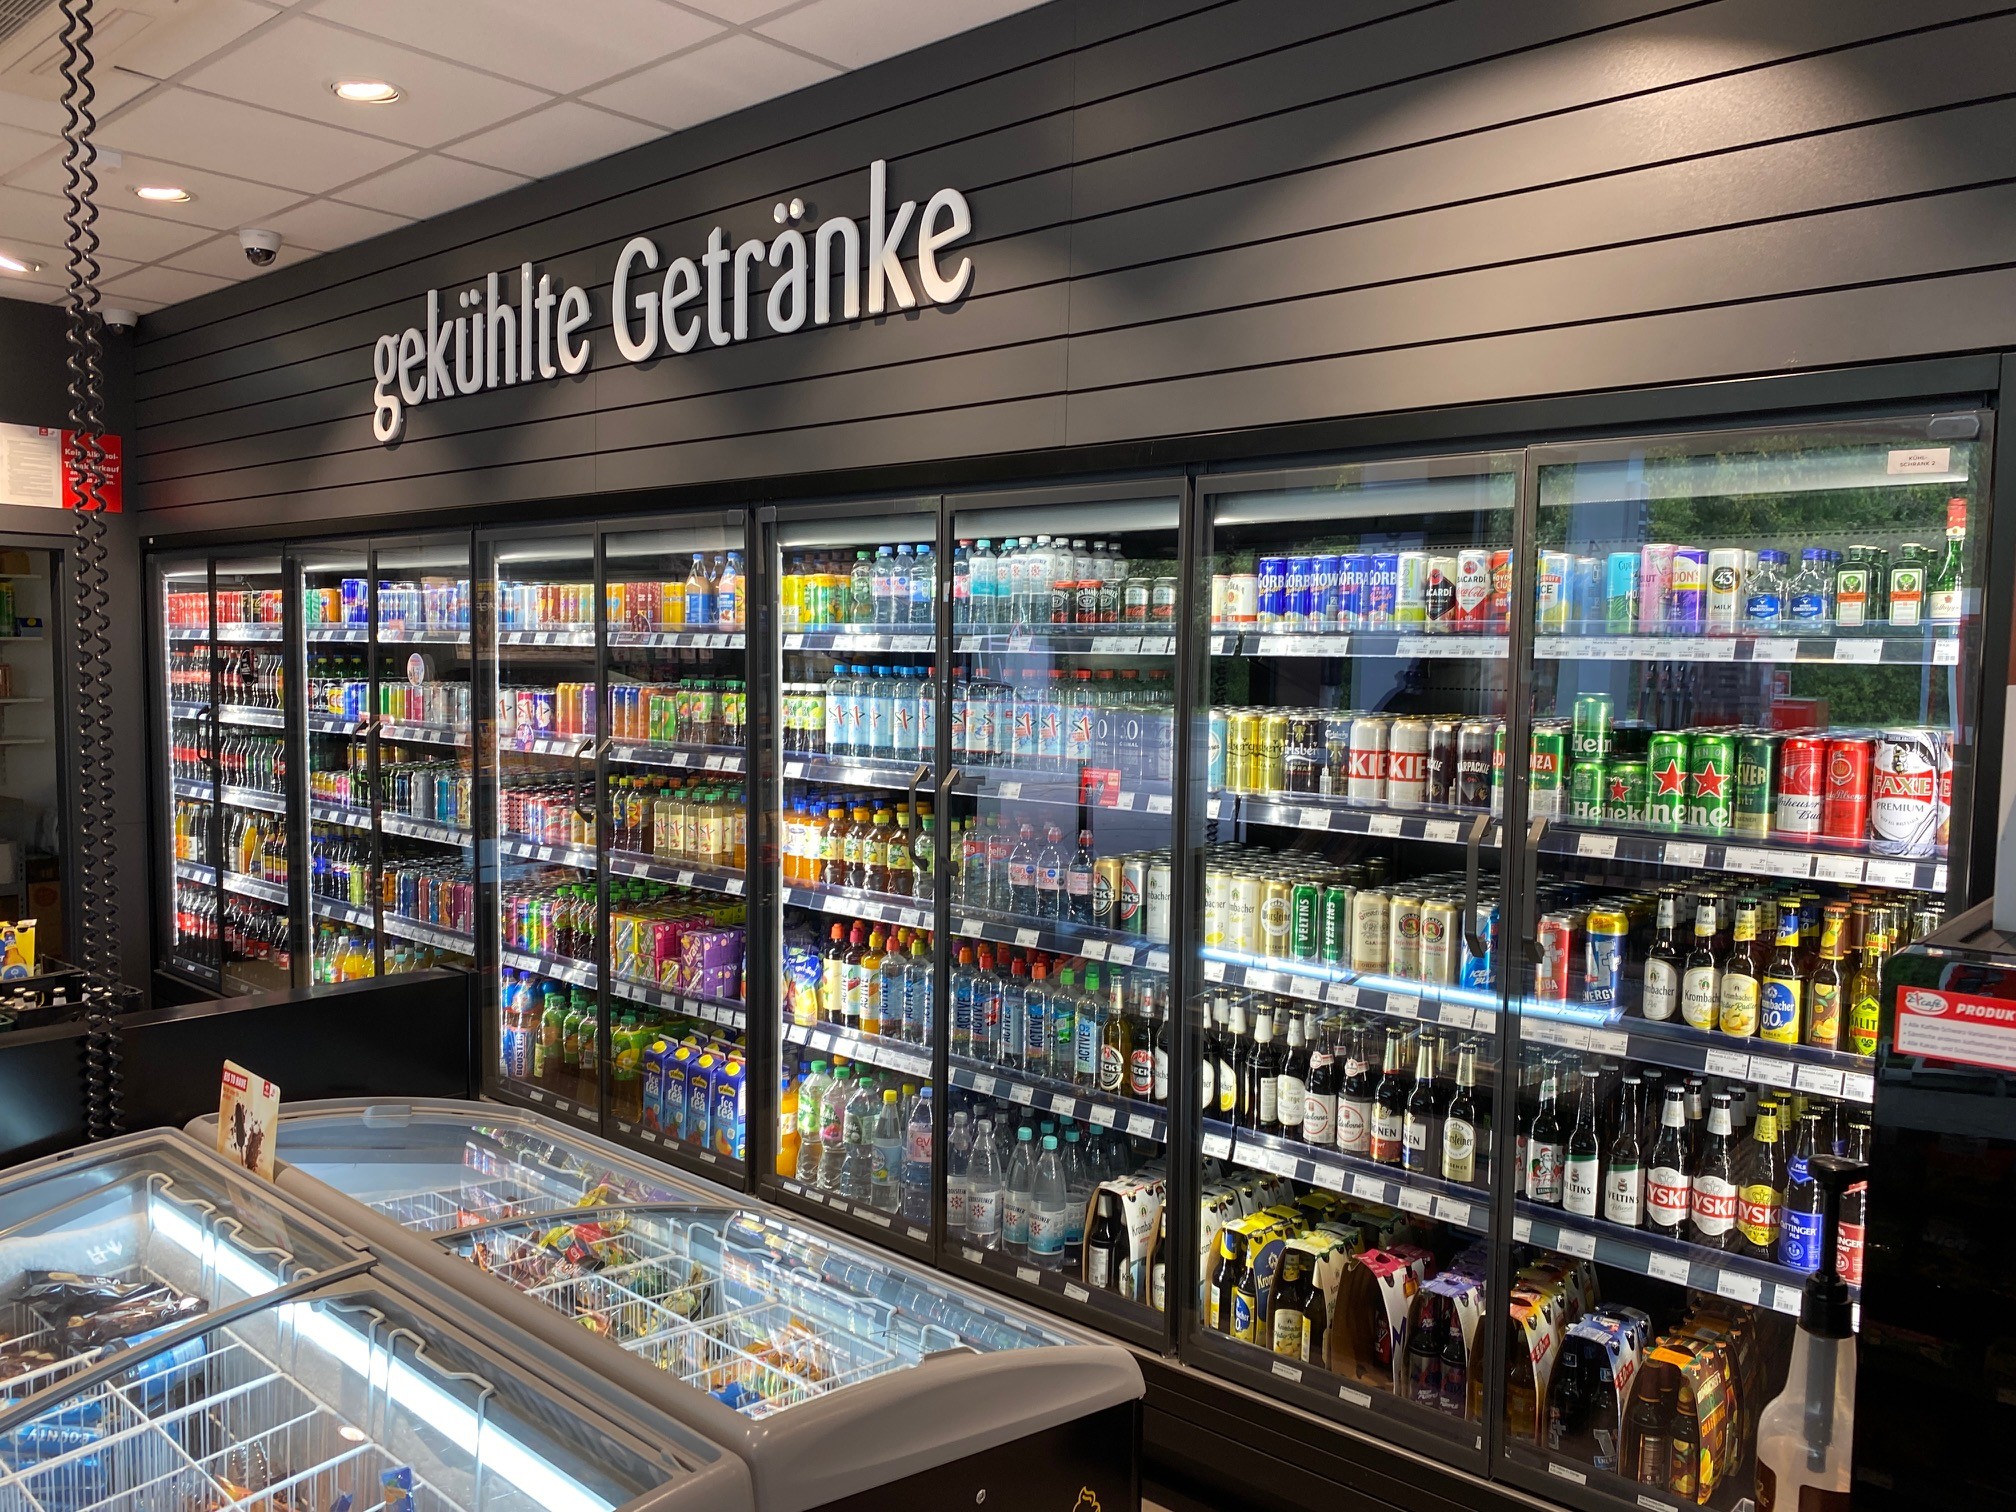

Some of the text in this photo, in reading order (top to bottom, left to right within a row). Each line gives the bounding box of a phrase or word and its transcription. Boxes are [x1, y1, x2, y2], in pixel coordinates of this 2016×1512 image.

[373, 159, 972, 442] gekühlte Getränke
[1714, 571, 1733, 585] 43
[1874, 774, 1932, 796] FAXE
[1876, 802, 1924, 812] PREMIUM
[1299, 898, 1310, 942] VELTINS
[1325, 901, 1336, 946] VELTINS
[684, 937, 701, 965] bravo
[957, 995, 970, 1029] ACTIVE
[1956, 1004, 2016, 1020] PRODUK
[1030, 1013, 1043, 1048] ACTIVE
[1079, 1031, 1090, 1062] ACTIVE
[515, 1033, 525, 1077] BOOSTER
[649, 1072, 658, 1084] ice
[646, 1081, 659, 1096] tea
[671, 1080, 682, 1092] ice
[694, 1087, 705, 1100] ice
[668, 1088, 682, 1103] tea
[721, 1096, 733, 1108] ice
[691, 1097, 705, 1111] tea
[717, 1105, 734, 1120] tea
[1608, 1191, 1639, 1203] VELTINS
